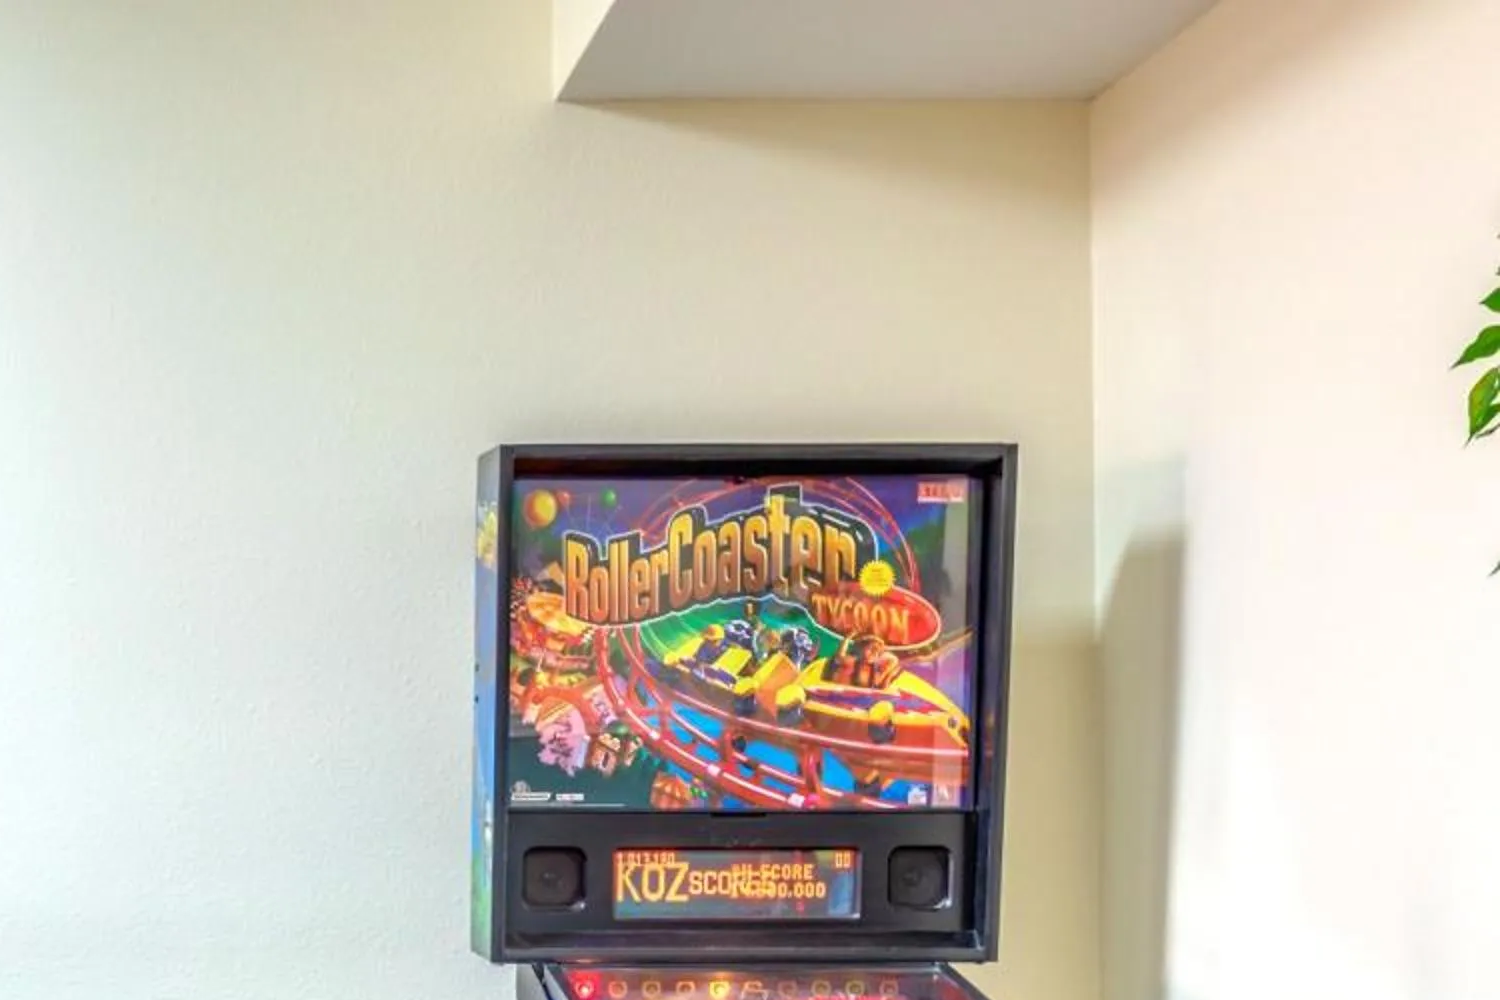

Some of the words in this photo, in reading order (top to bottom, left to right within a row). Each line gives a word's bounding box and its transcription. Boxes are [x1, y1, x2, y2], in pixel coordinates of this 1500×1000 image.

[566, 493, 857, 623] RollerCoaster
[812, 595, 911, 645] TYCOON
[616, 862, 690, 902] KOZ
